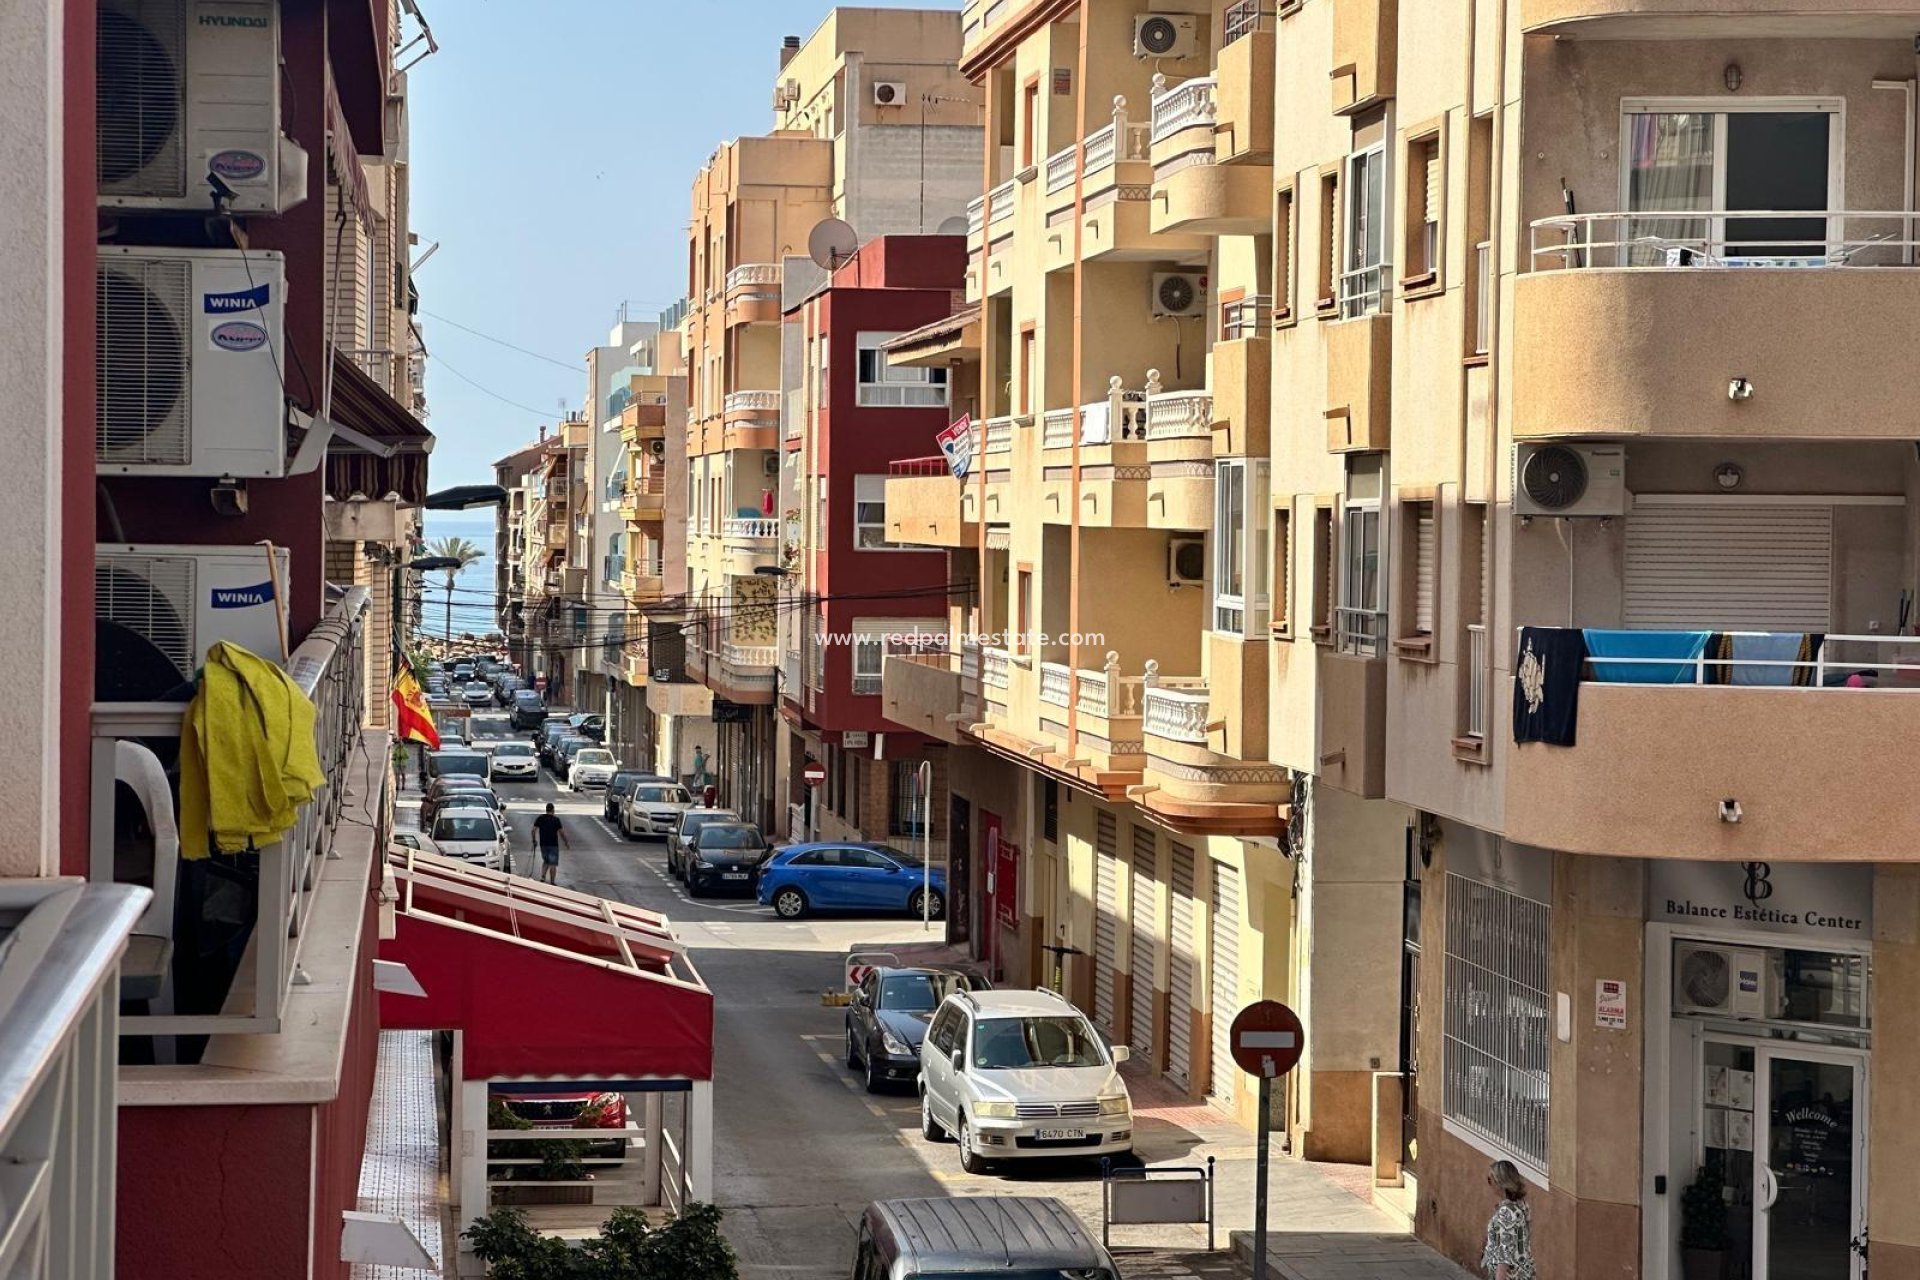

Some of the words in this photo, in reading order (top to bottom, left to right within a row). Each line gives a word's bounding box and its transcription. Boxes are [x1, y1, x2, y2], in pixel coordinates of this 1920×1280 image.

[199, 15, 267, 28] HYUNDAI
[210, 297, 257, 309] WINIA
[217, 592, 264, 604] WINIA
[1666, 900, 1728, 918] Balance
[1734, 904, 1799, 924] Estética
[1805, 911, 1862, 930] Center
[1785, 1106, 1838, 1128] Wellcome
